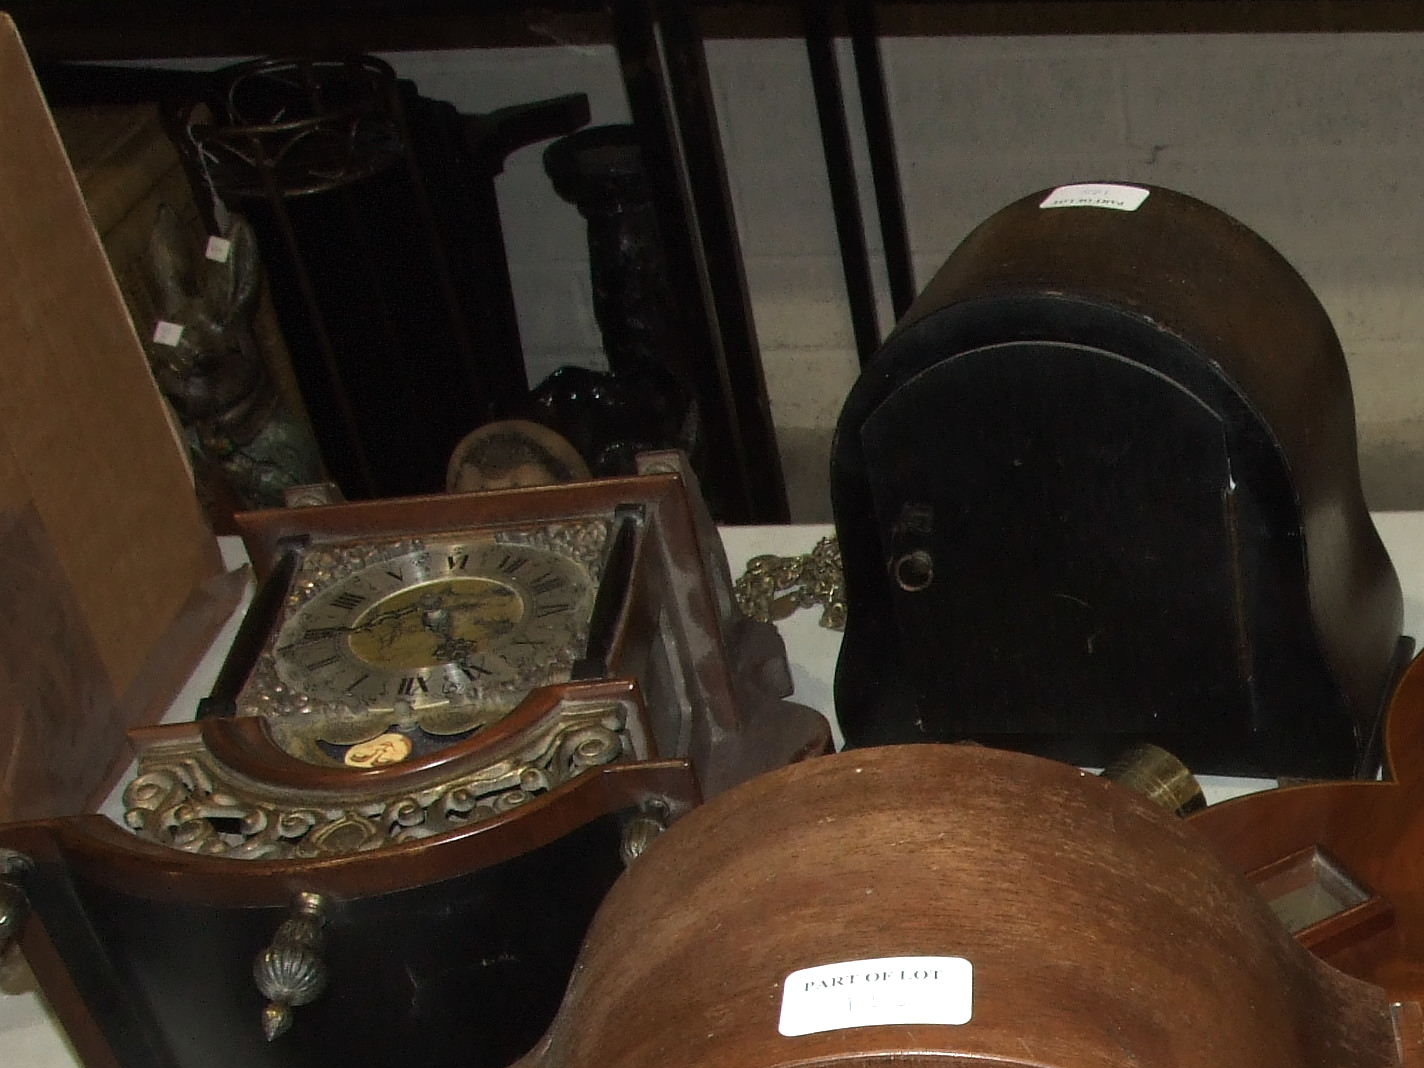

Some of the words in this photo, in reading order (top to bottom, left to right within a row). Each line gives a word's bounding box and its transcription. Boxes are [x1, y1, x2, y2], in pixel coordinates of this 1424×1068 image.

[804, 975, 859, 992] PART
[865, 971, 893, 983] OF
[900, 970, 943, 981] LOT
